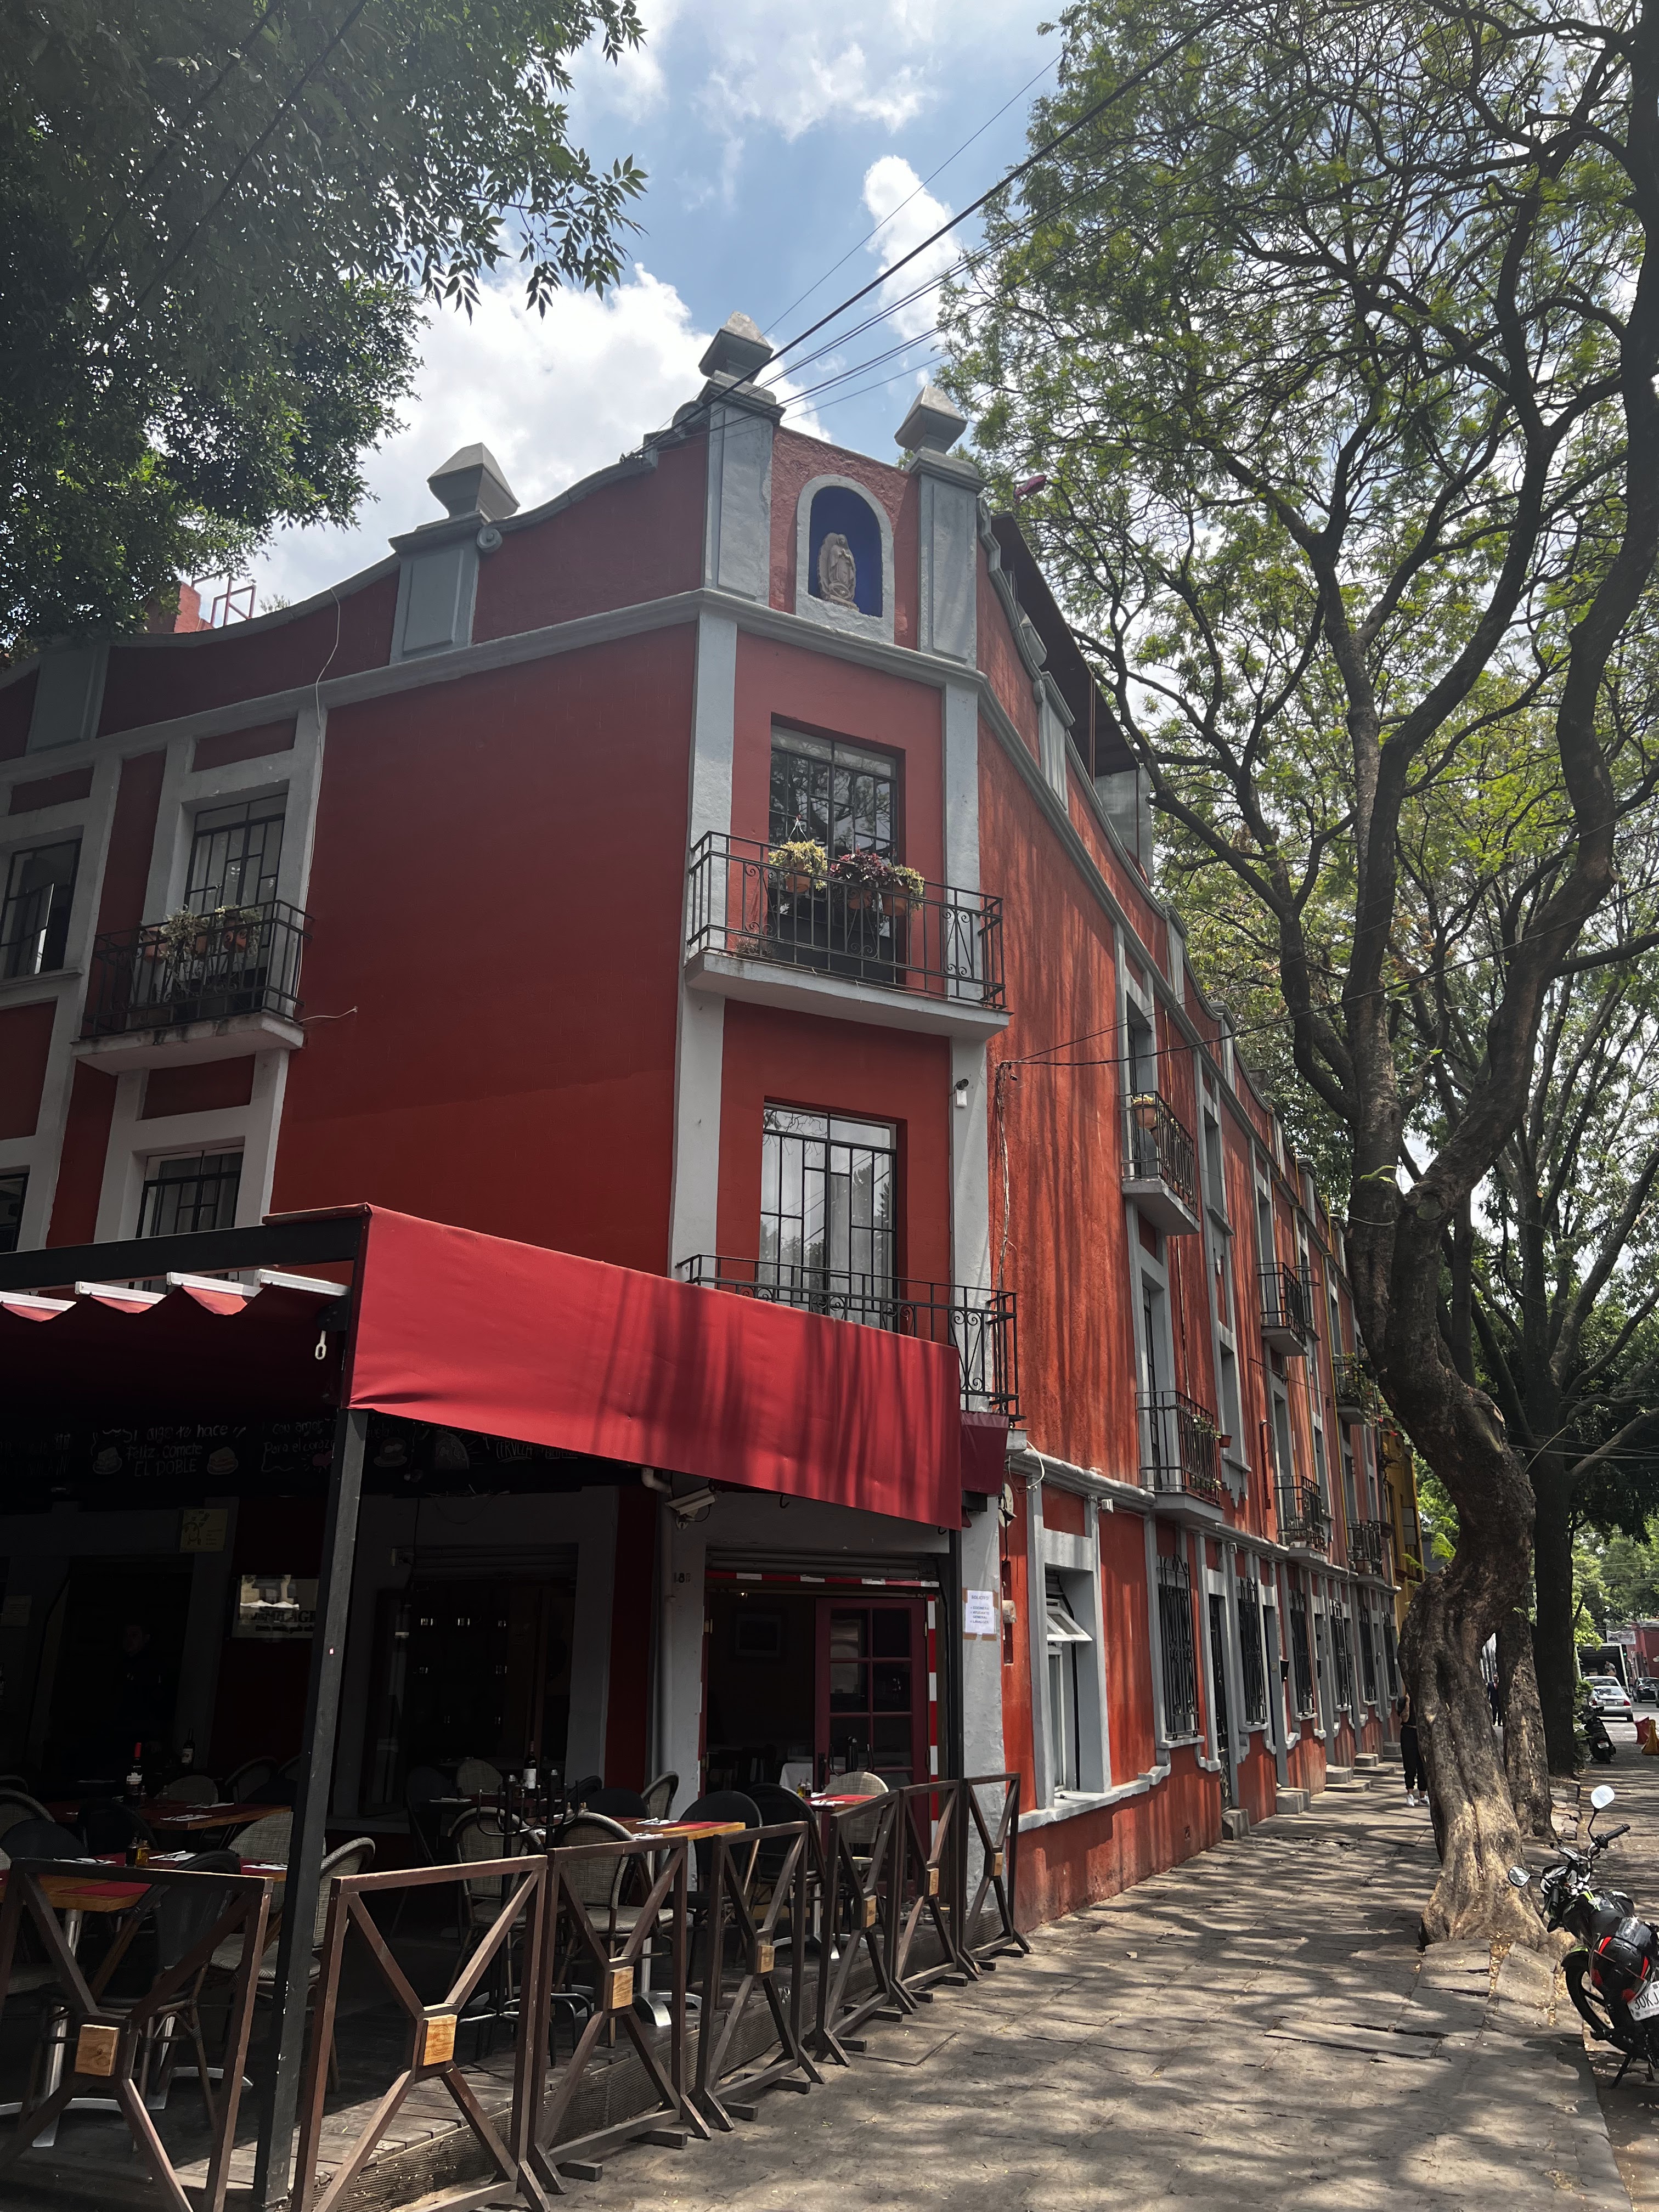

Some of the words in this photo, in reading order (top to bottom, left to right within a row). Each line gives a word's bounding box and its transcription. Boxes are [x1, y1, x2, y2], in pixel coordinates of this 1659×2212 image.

[196, 1424, 229, 1438] hace
[134, 1460, 150, 1477] EL
[155, 1458, 198, 1477] DOBLE
